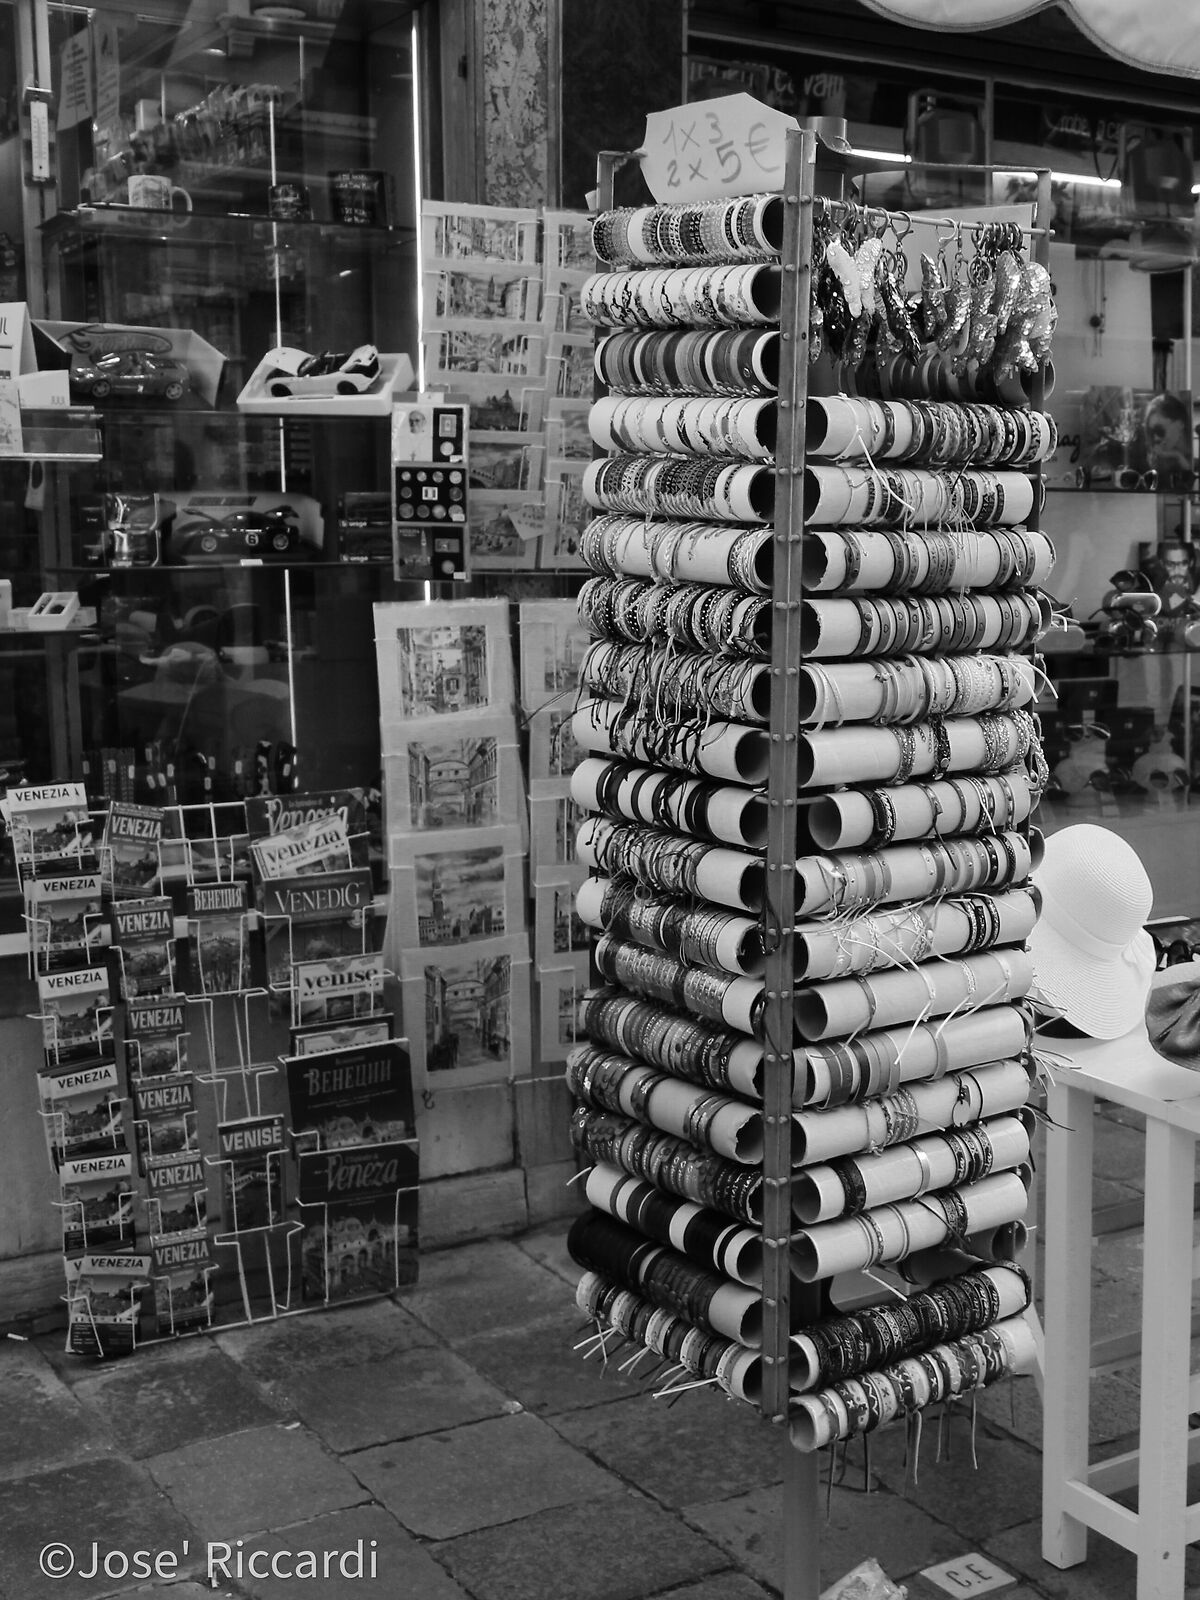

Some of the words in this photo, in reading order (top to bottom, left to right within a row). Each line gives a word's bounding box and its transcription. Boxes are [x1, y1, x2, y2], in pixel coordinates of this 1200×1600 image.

[16, 787, 70, 802] VENEZIA
[112, 815, 162, 839] VENEZIA
[44, 878, 97, 893] VENEZIA
[275, 882, 362, 914] VENEDIG
[117, 910, 171, 934] VENEZIA
[47, 971, 103, 989] VENEZIA
[130, 1006, 183, 1030] VENEZIA
[57, 1069, 112, 1090] VENEZIA
[138, 1085, 192, 1111] VENEZIA
[222, 1125, 282, 1152] VENISE
[72, 1158, 126, 1174] VENEZIA
[150, 1163, 204, 1188] VENEZIA
[326, 1153, 399, 1192] Veneza
[90, 1257, 144, 1269] VENEZIA
[155, 1240, 209, 1266] VENEZIA
